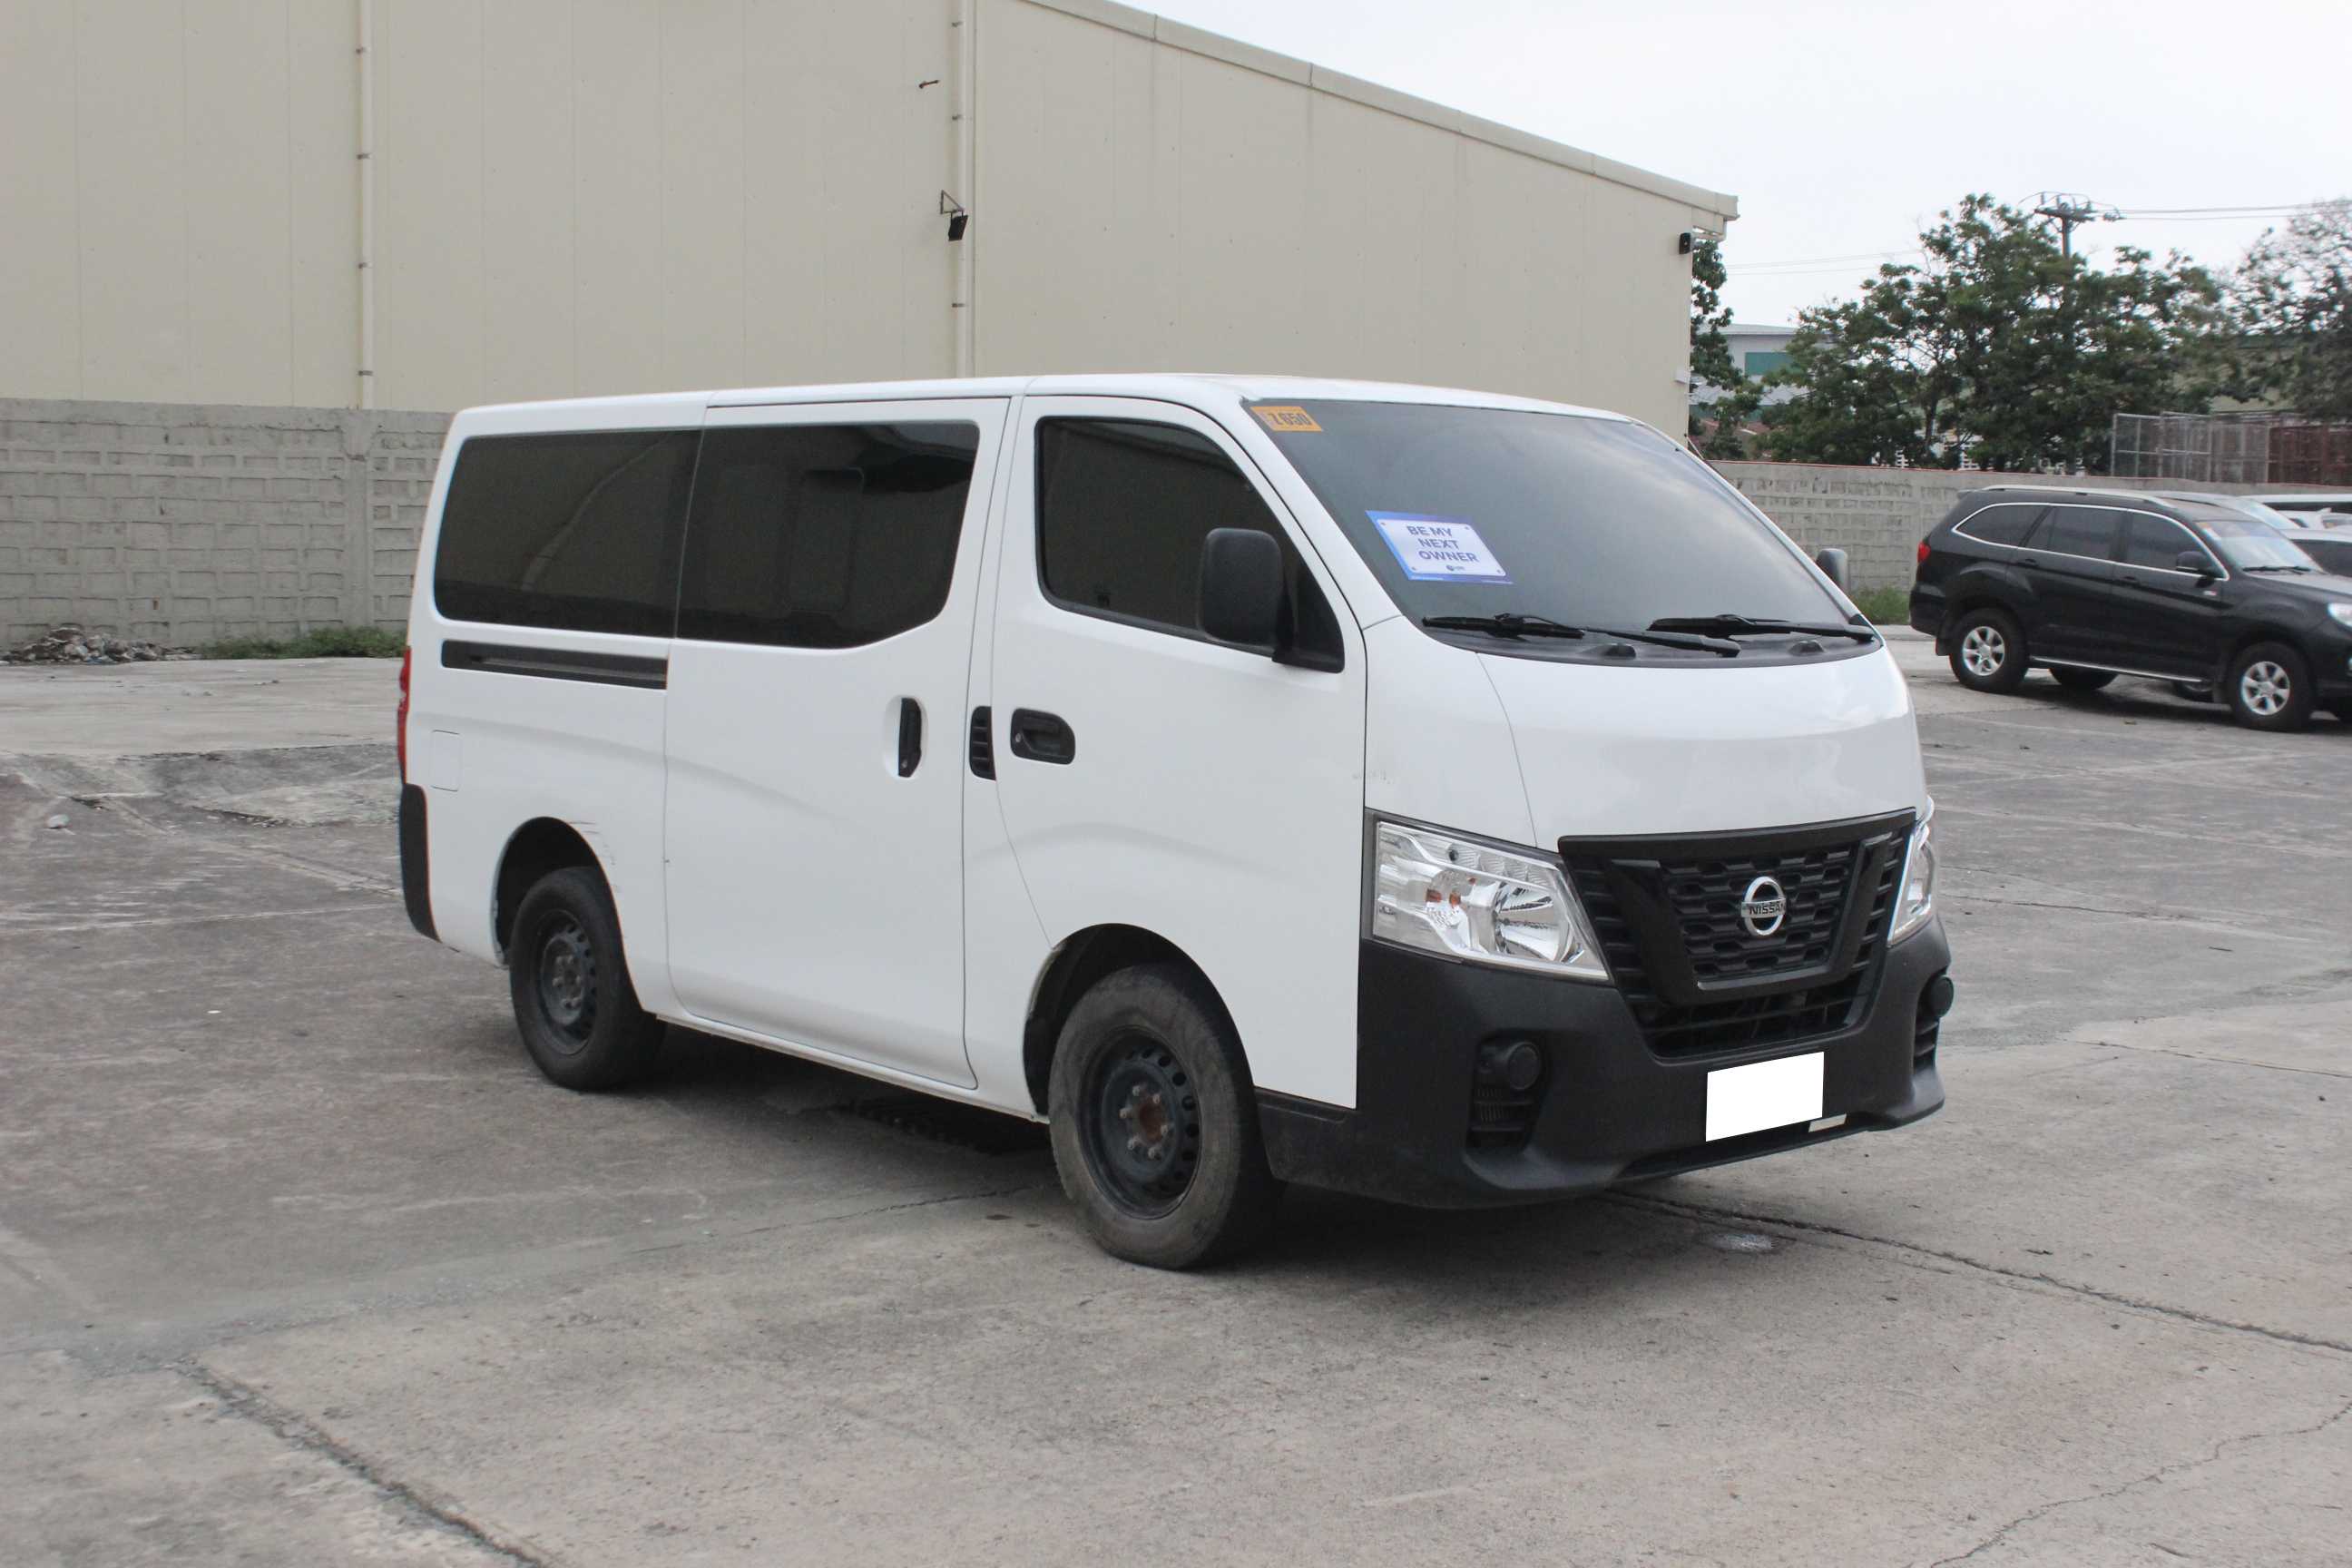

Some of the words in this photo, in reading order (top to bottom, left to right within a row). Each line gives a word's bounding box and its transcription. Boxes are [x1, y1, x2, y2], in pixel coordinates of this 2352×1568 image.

[1406, 525, 1429, 536] BE
[1430, 527, 1453, 537] MY
[1417, 538, 1459, 549] NEXT
[1418, 551, 1479, 563] OWNER
